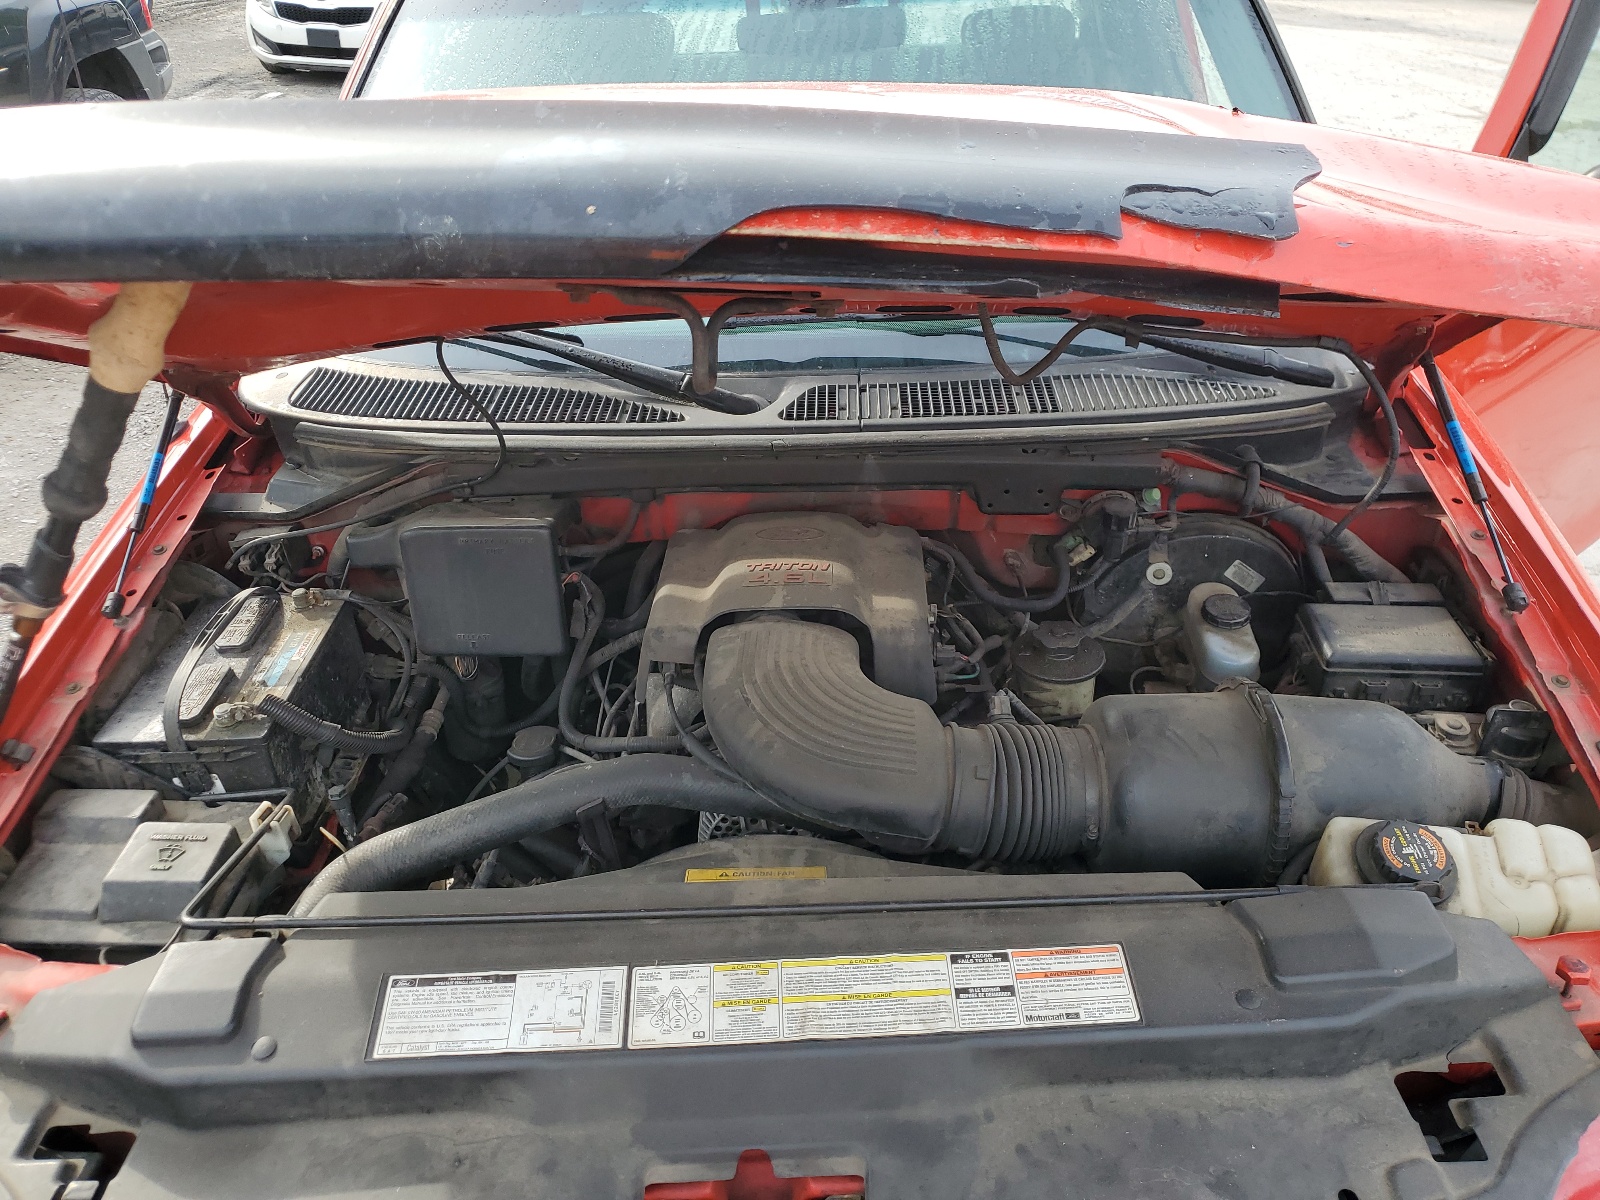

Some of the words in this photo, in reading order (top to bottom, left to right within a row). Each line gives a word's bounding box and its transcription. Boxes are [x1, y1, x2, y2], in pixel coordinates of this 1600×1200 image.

[747, 562, 830, 572] TRITON
[748, 573, 828, 584] 4.6L
[1408, 856, 1422, 874] ENGINE
[1025, 1014, 1065, 1023] Motorcraft
